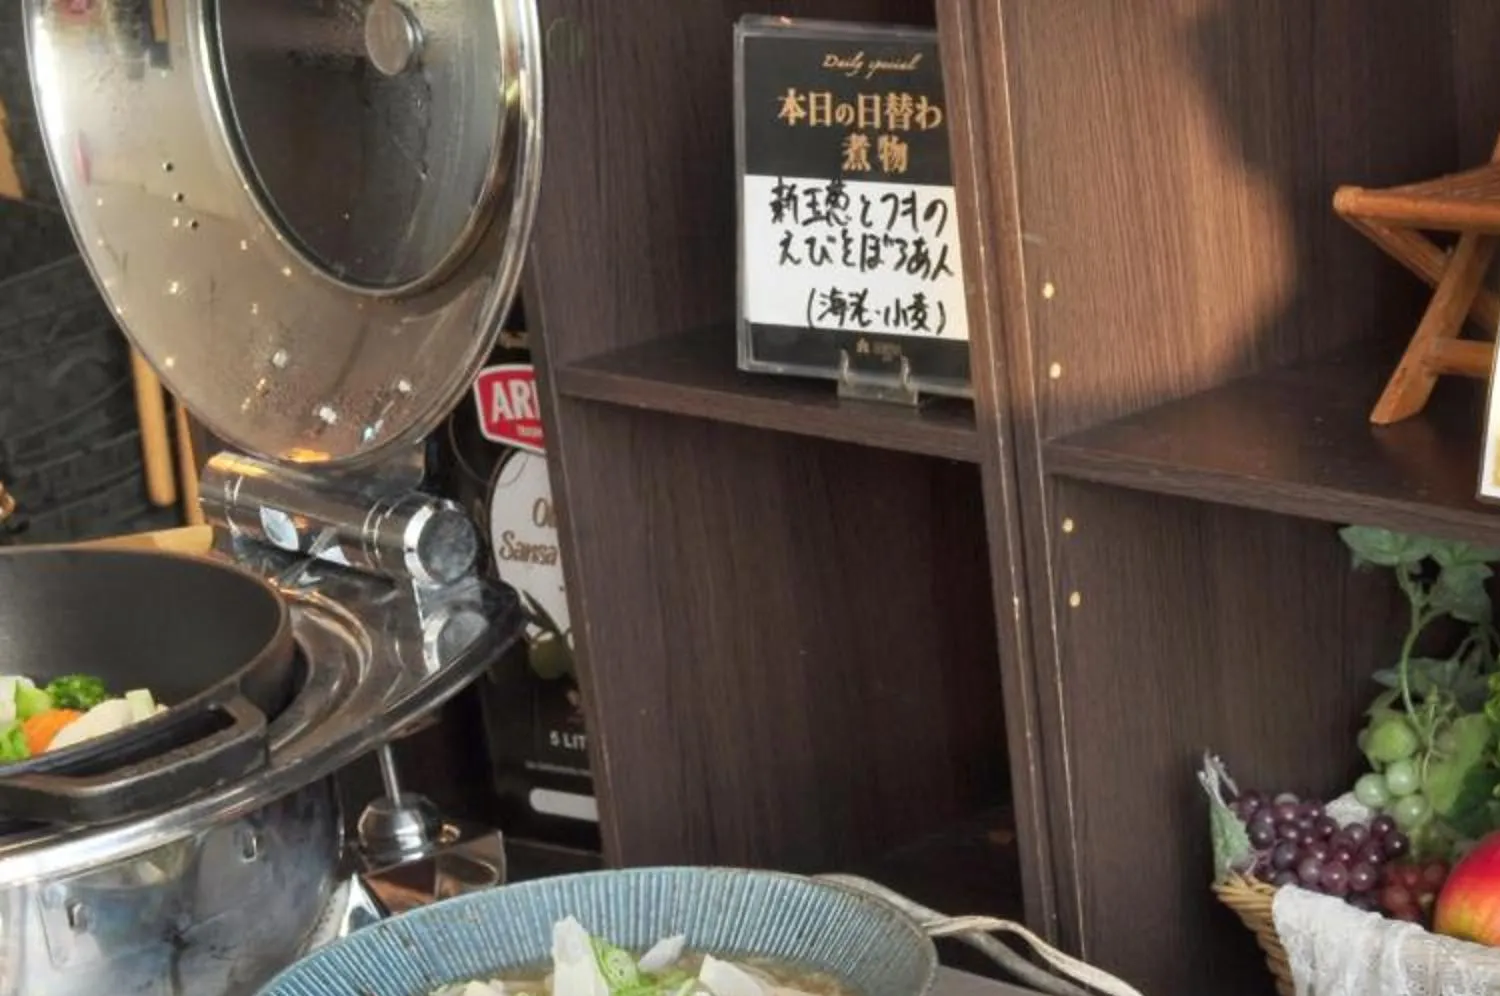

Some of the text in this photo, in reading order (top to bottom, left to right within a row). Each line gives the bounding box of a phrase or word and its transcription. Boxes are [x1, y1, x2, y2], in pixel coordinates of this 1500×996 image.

[822, 51, 920, 78] Daily special
[841, 132, 908, 173] 煮物
